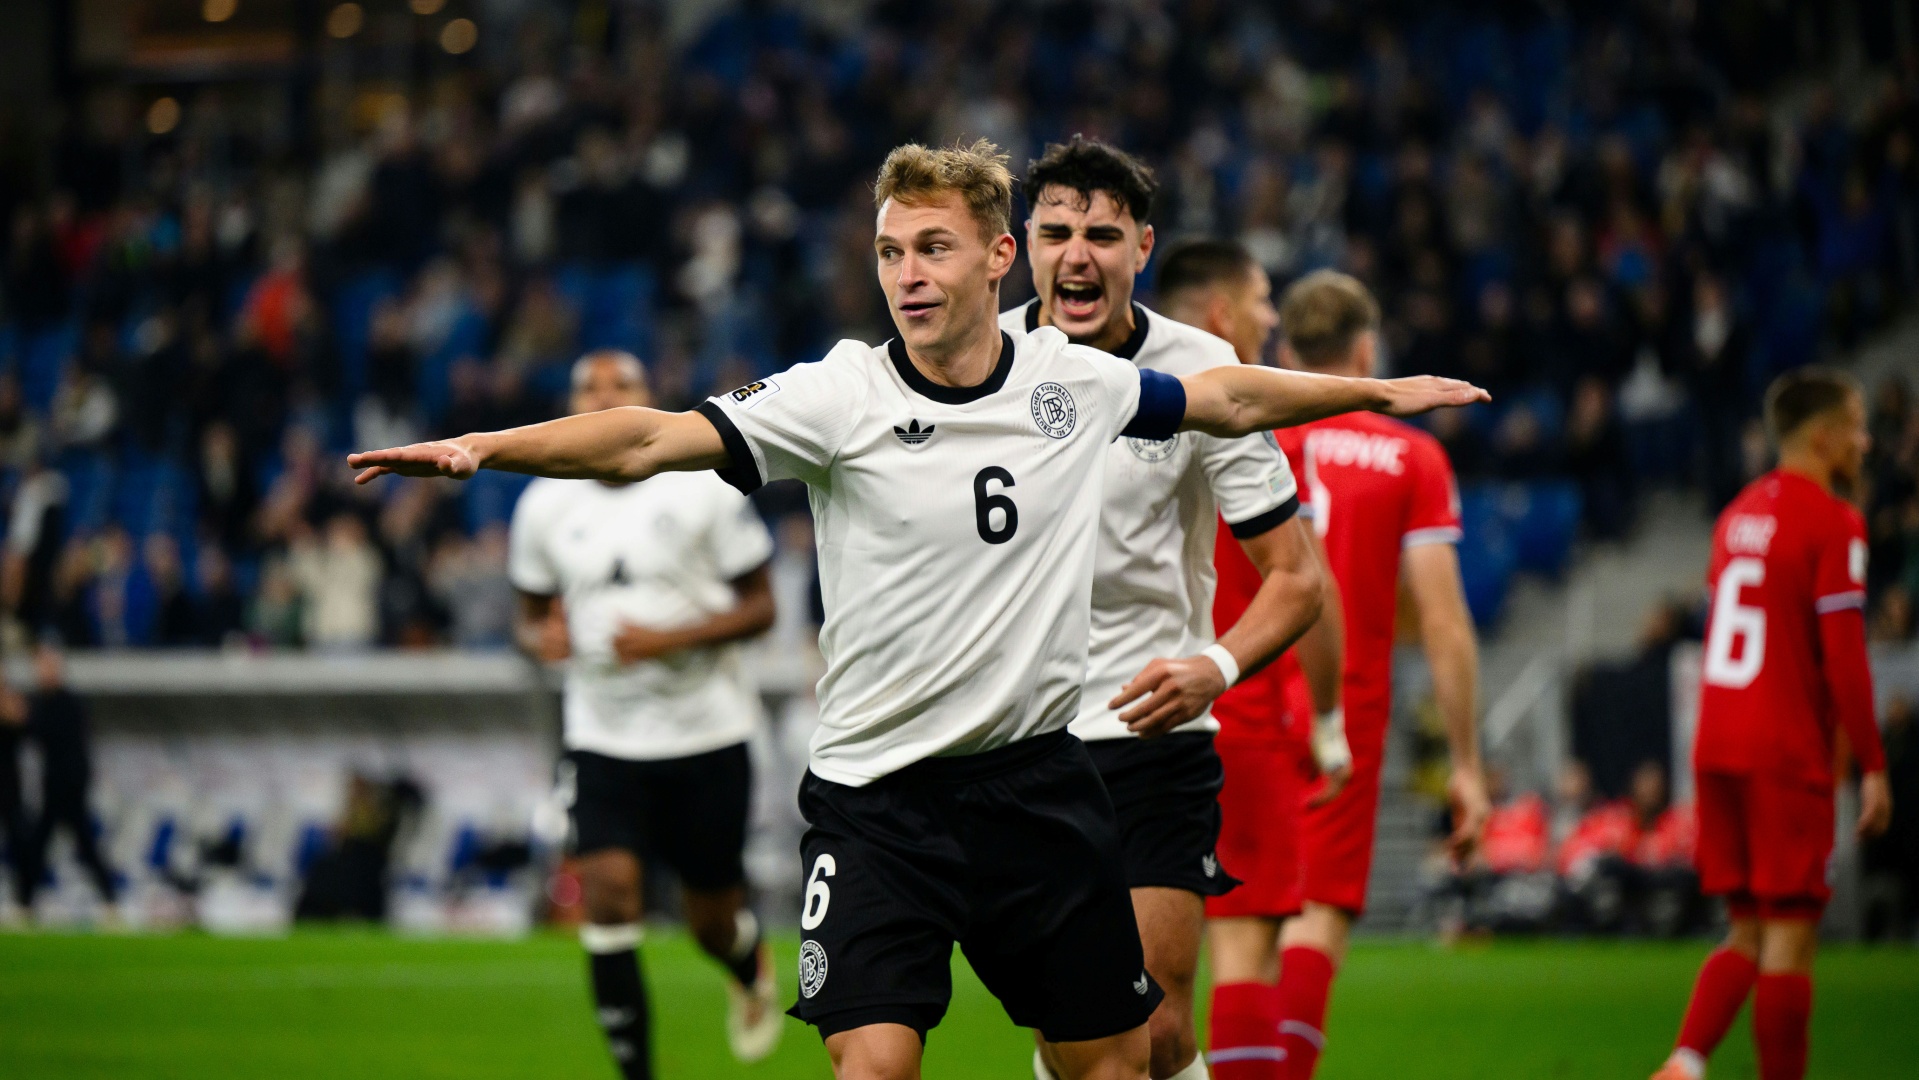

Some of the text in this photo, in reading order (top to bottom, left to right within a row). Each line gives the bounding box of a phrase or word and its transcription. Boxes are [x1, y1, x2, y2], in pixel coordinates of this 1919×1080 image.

[1033, 391, 1052, 434] DEUTSCHER
[973, 465, 1019, 545] 6
[1704, 556, 1766, 690] 6
[801, 853, 837, 931] 6
